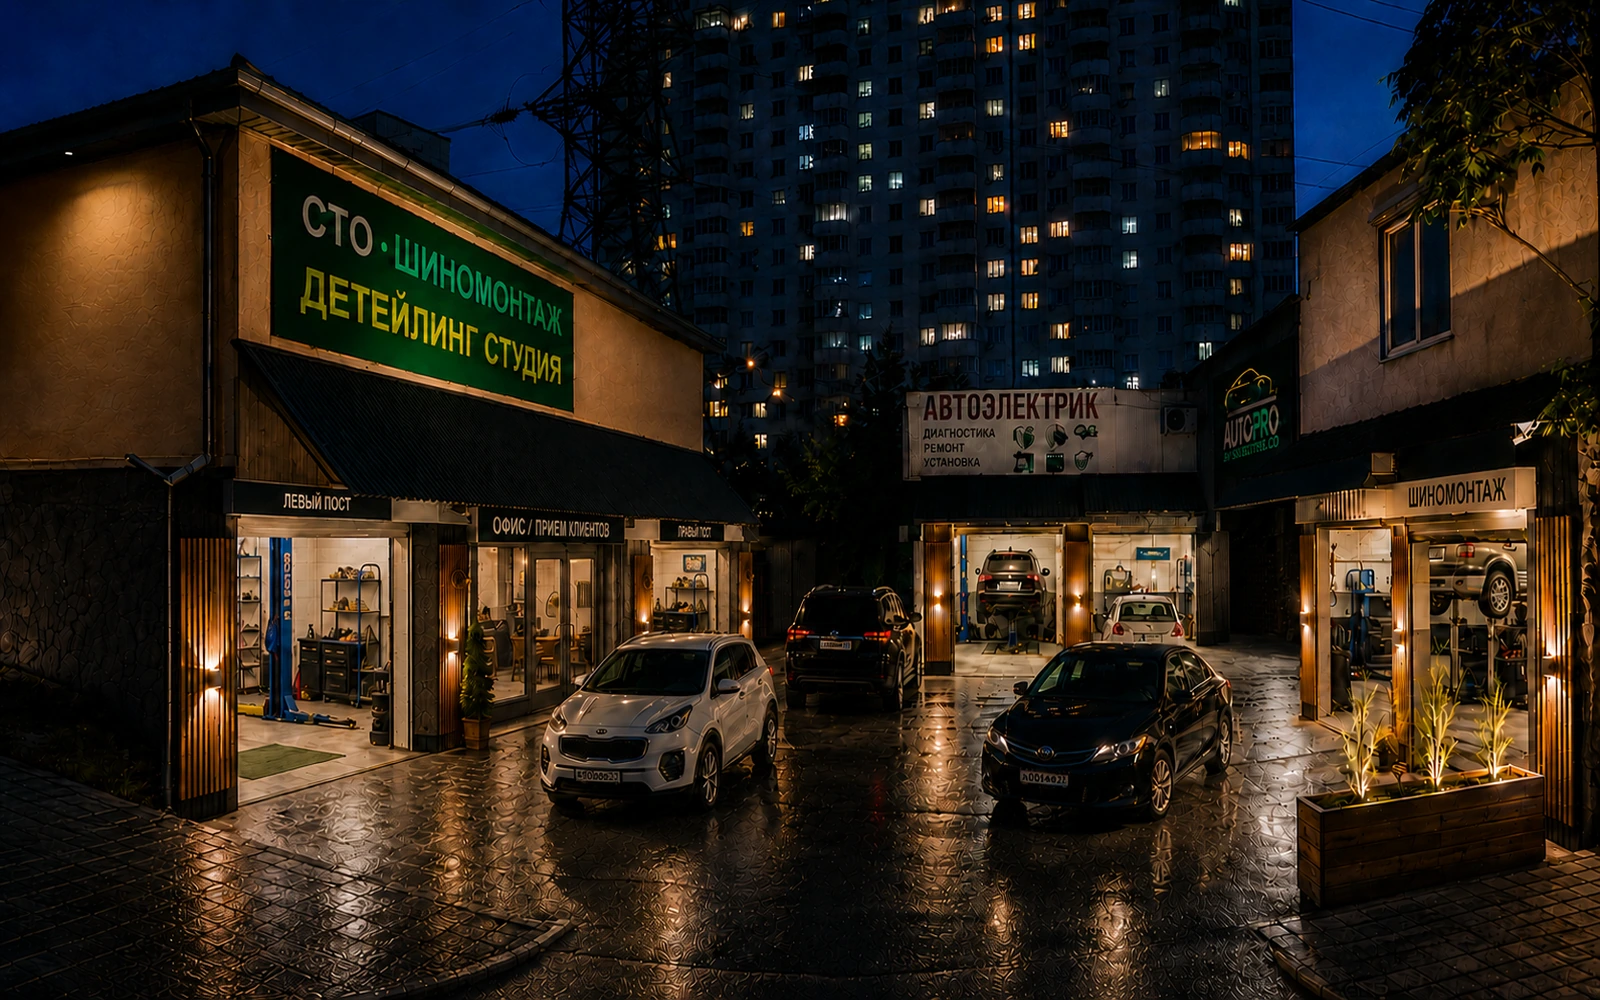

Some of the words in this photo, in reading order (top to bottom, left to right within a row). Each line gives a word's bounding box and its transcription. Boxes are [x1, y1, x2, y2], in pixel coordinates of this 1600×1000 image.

[302, 195, 374, 257] СТО
[395, 234, 563, 336] ШИНОМОНТАЖ
[300, 266, 479, 358] ДЕТЕЙЛИНГ
[484, 332, 562, 385] СТУДИЯ
[923, 391, 1099, 421] АВТОЭЛЕКТРИК
[923, 427, 996, 441] ДИАГНОСТИКА
[924, 442, 965, 453] РЕМОНТ
[924, 457, 980, 468] УСТАНОВКА
[283, 491, 322, 510] ЛЕВЫЙ
[323, 496, 352, 511] ПОСТ
[1408, 477, 1506, 508] ШИНОМОНТАЖ
[492, 516, 526, 535] ОФИС
[535, 518, 567, 537] ПРИЕМ
[568, 521, 610, 538] КЛИЕНТОВ
